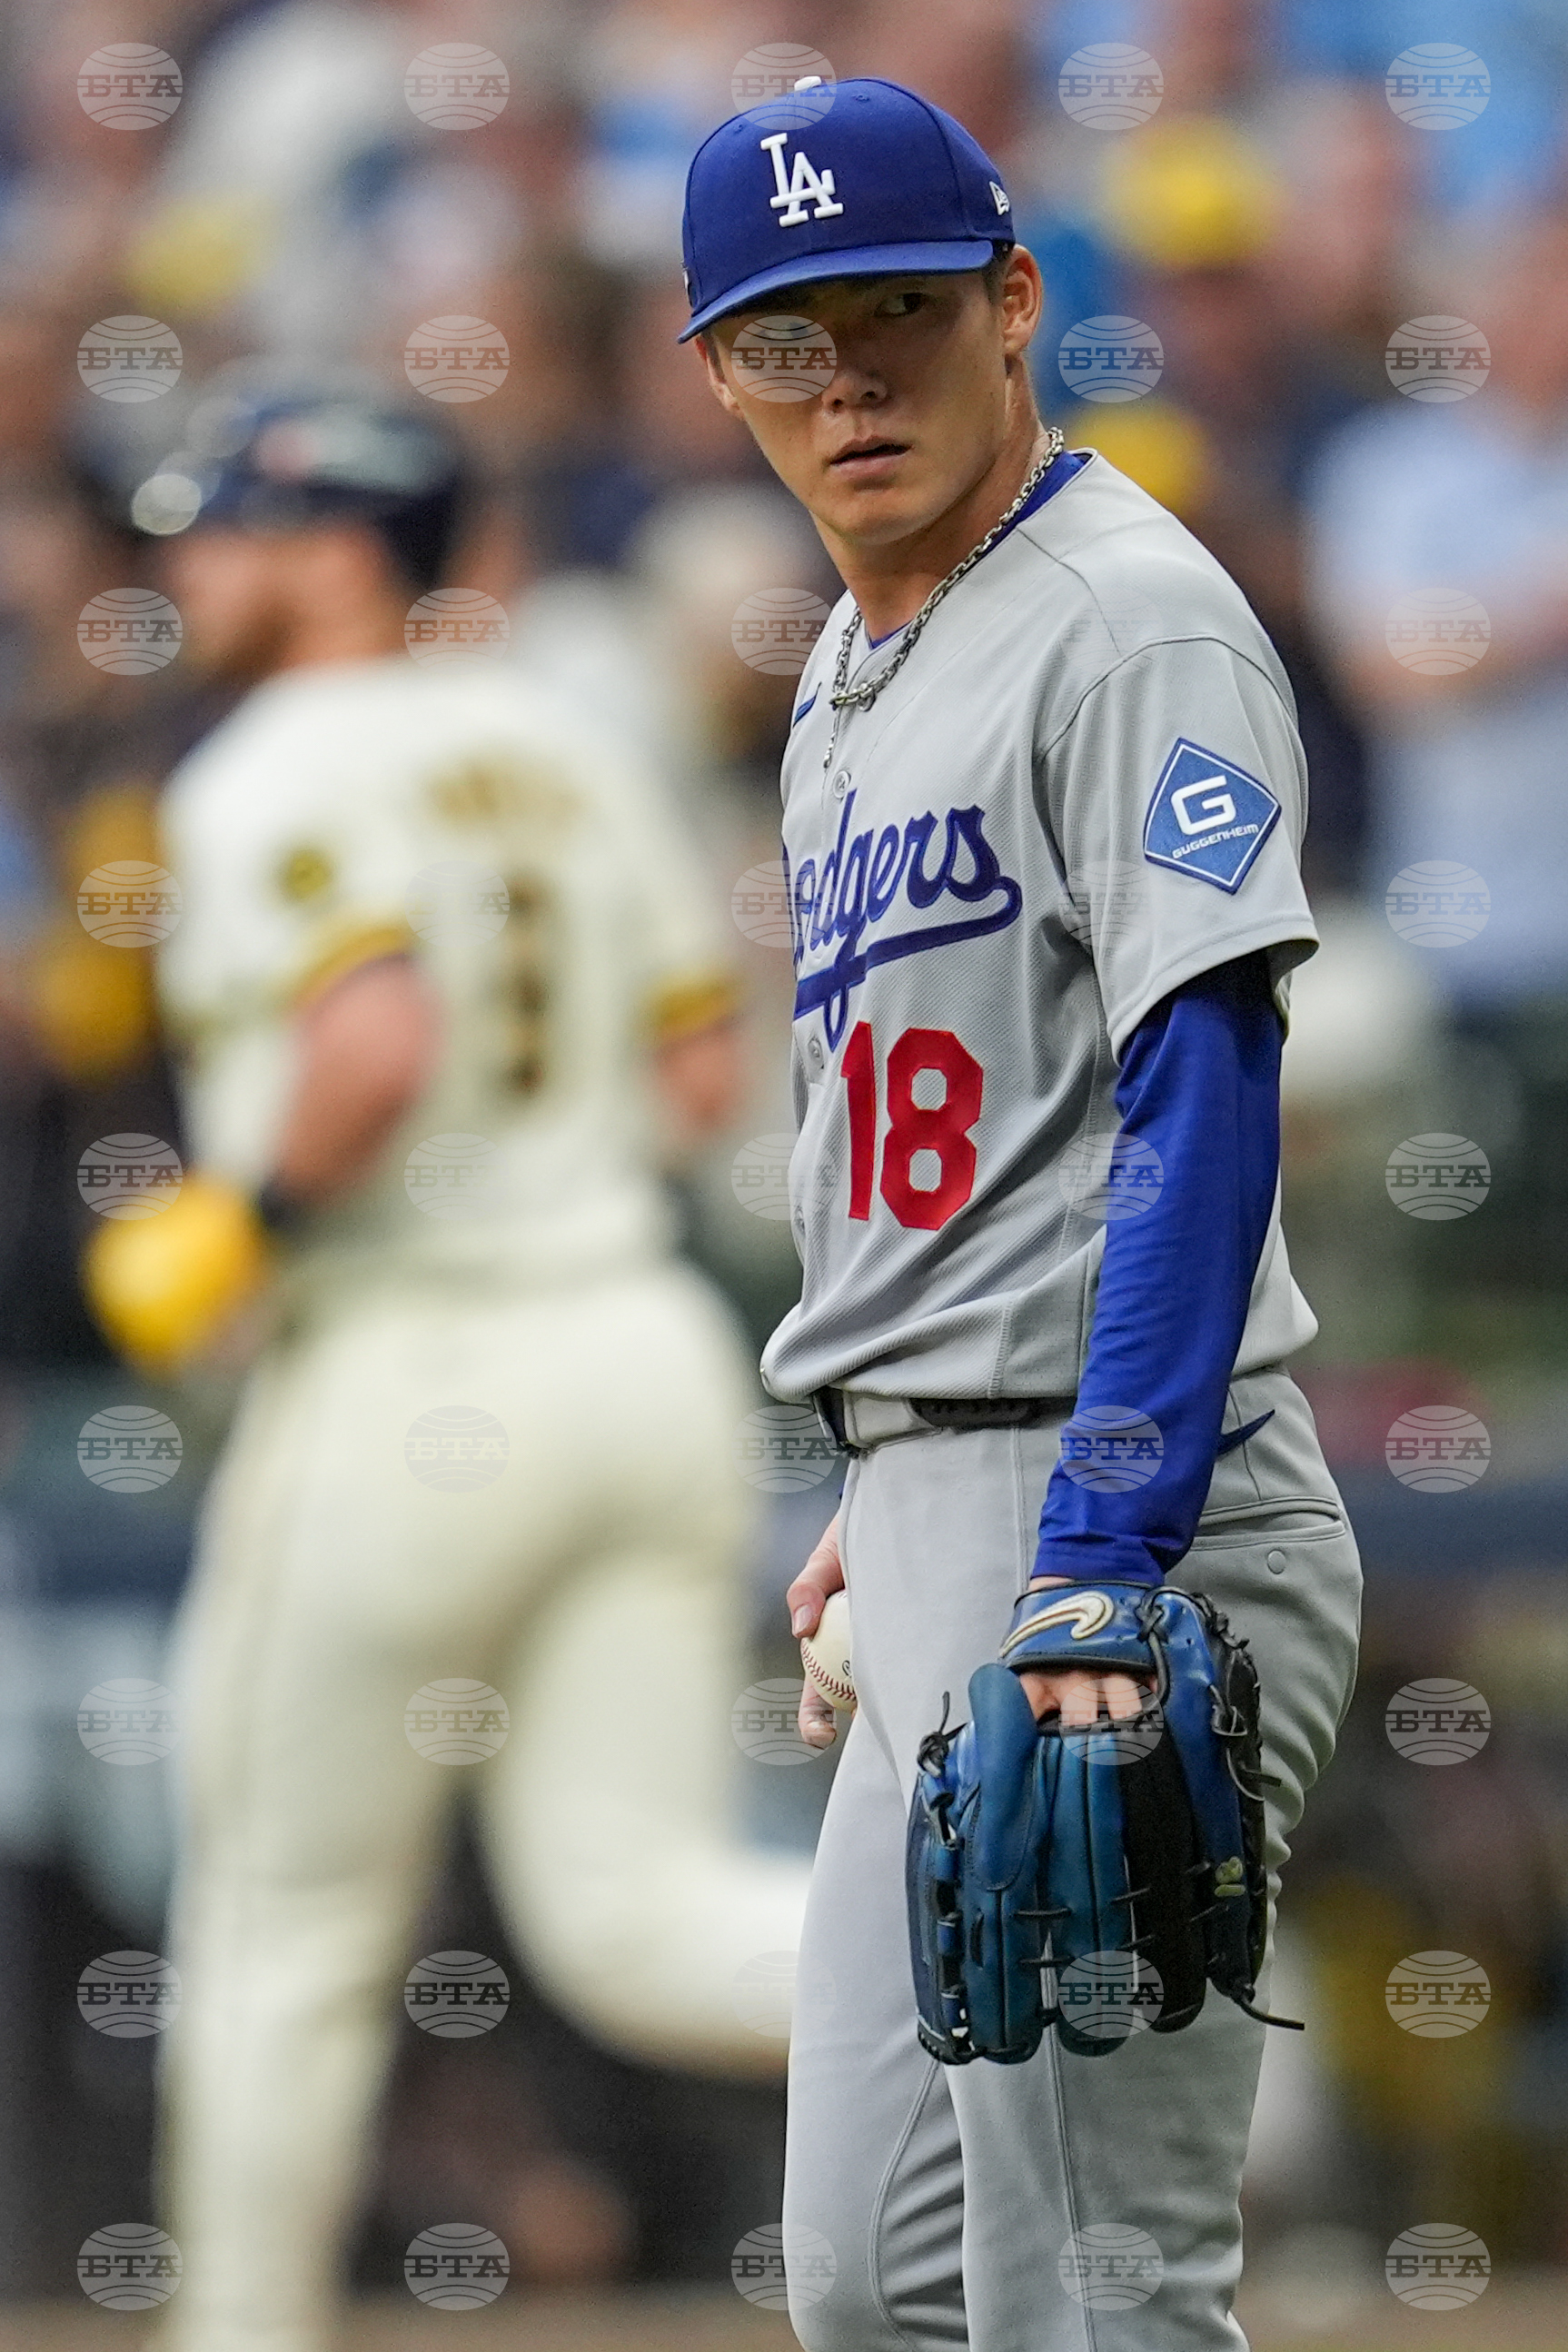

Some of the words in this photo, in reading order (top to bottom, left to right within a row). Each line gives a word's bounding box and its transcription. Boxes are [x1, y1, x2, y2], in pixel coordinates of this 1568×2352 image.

[760, 133, 843, 227] LA
[1170, 775, 1236, 835] G
[1172, 823, 1259, 858] GUGGENHEIM
[785, 788, 1023, 1054] odgers
[841, 1020, 983, 1230] 18
